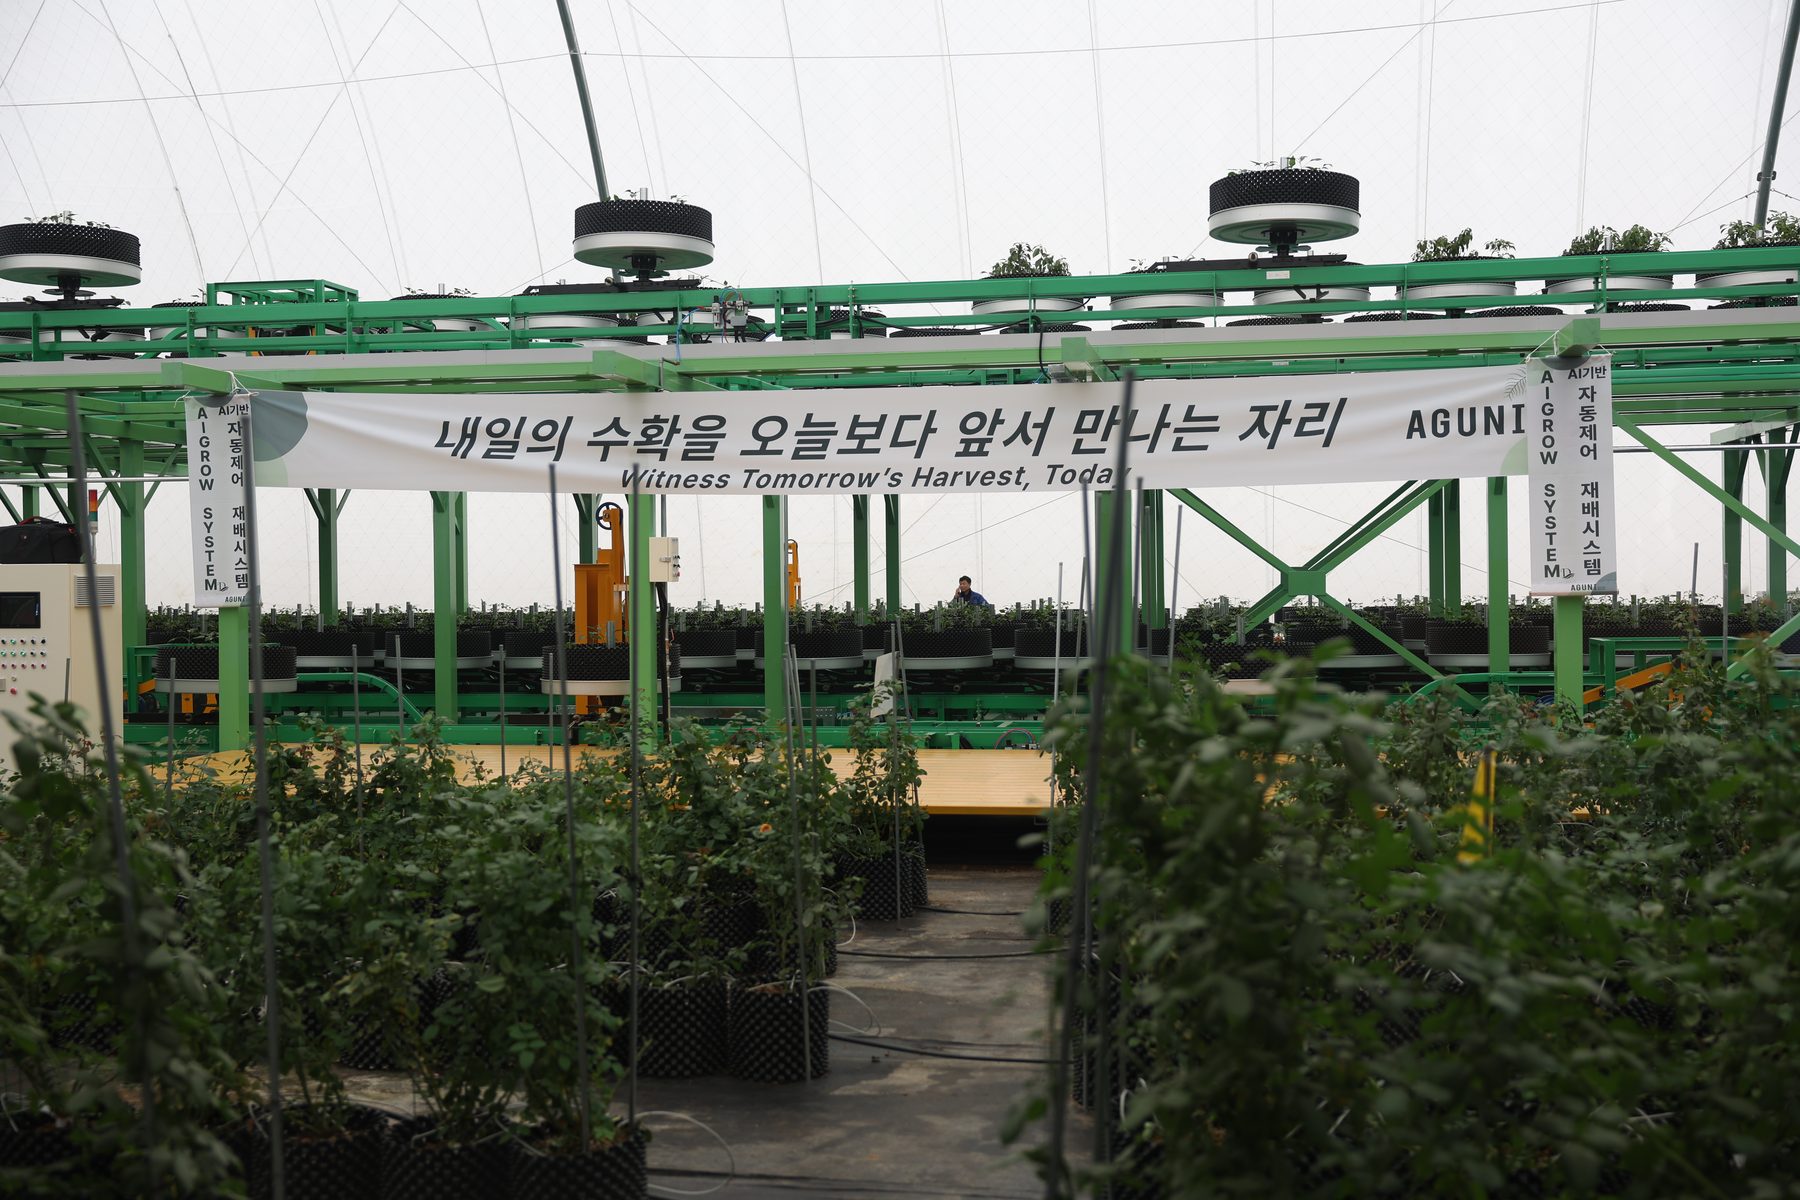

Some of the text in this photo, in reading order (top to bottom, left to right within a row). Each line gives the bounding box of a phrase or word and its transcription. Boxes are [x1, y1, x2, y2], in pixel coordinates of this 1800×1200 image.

[1567, 365, 1608, 379] AI기반
[434, 397, 1348, 462] 내일의 수확을 오늘보다 앞서 만나는 자리
[1406, 403, 1526, 440] AGUNI
[1578, 385, 1597, 460] 자동제어
[197, 407, 217, 591] AIGROW SYSTEM
[218, 403, 250, 589] AI기반 자동제어 재배시스템
[621, 468, 731, 489] Witness
[742, 467, 904, 489] Tomorrow’s
[911, 465, 1030, 492] Harvest,
[1539, 369, 1560, 578] AIGROW SYSTEM
[1580, 481, 1602, 576] 재배시스템
